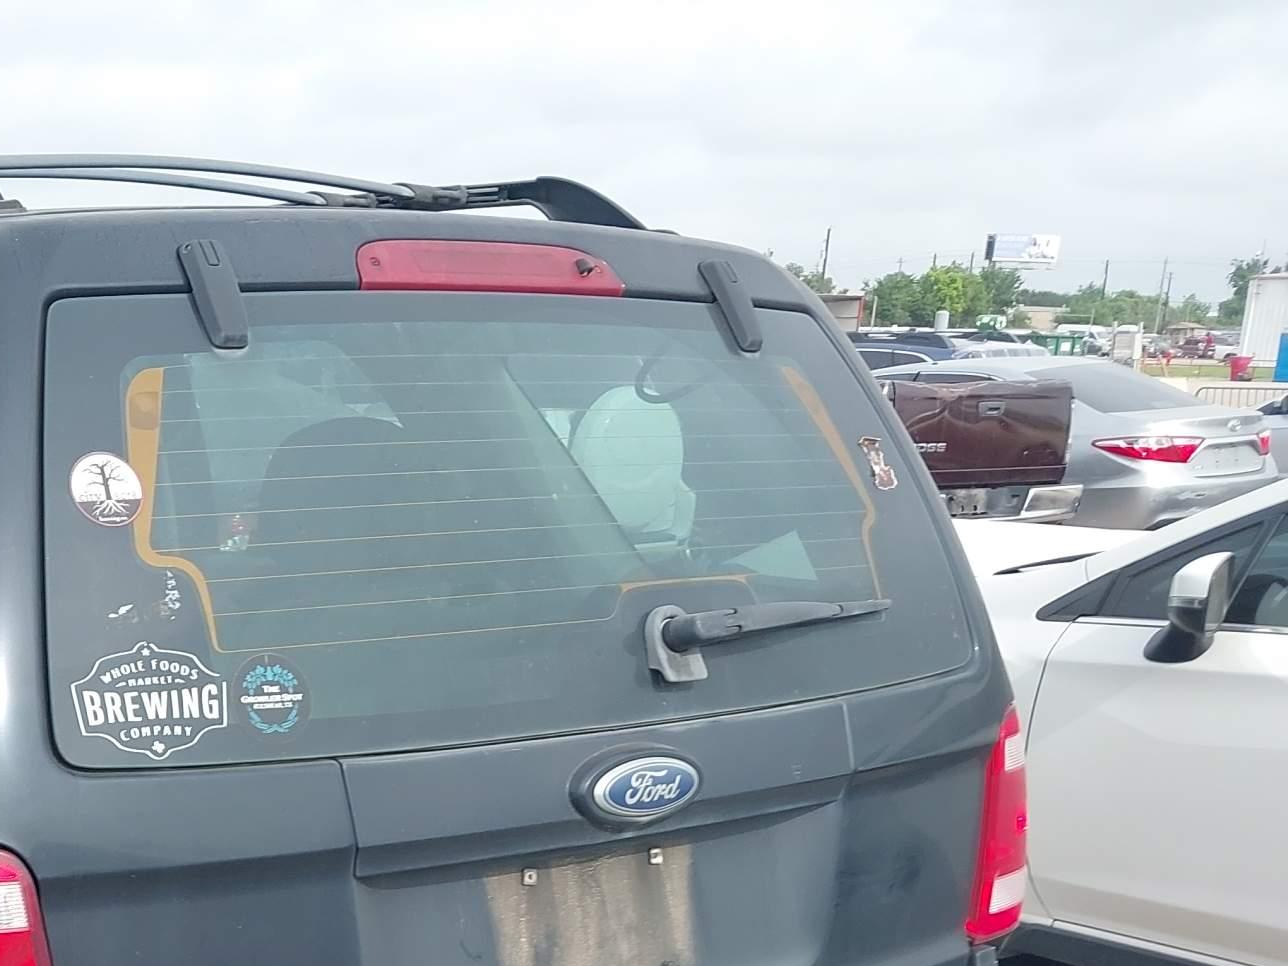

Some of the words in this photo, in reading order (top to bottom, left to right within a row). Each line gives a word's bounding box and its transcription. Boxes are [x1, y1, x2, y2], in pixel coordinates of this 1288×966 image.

[99, 660, 146, 684] WHOLE
[150, 658, 199, 680] FOODS
[127, 675, 173, 687] MARKET
[82, 683, 220, 727] BREWING
[119, 725, 193, 742] COMPANY
[624, 769, 682, 805] Ford
